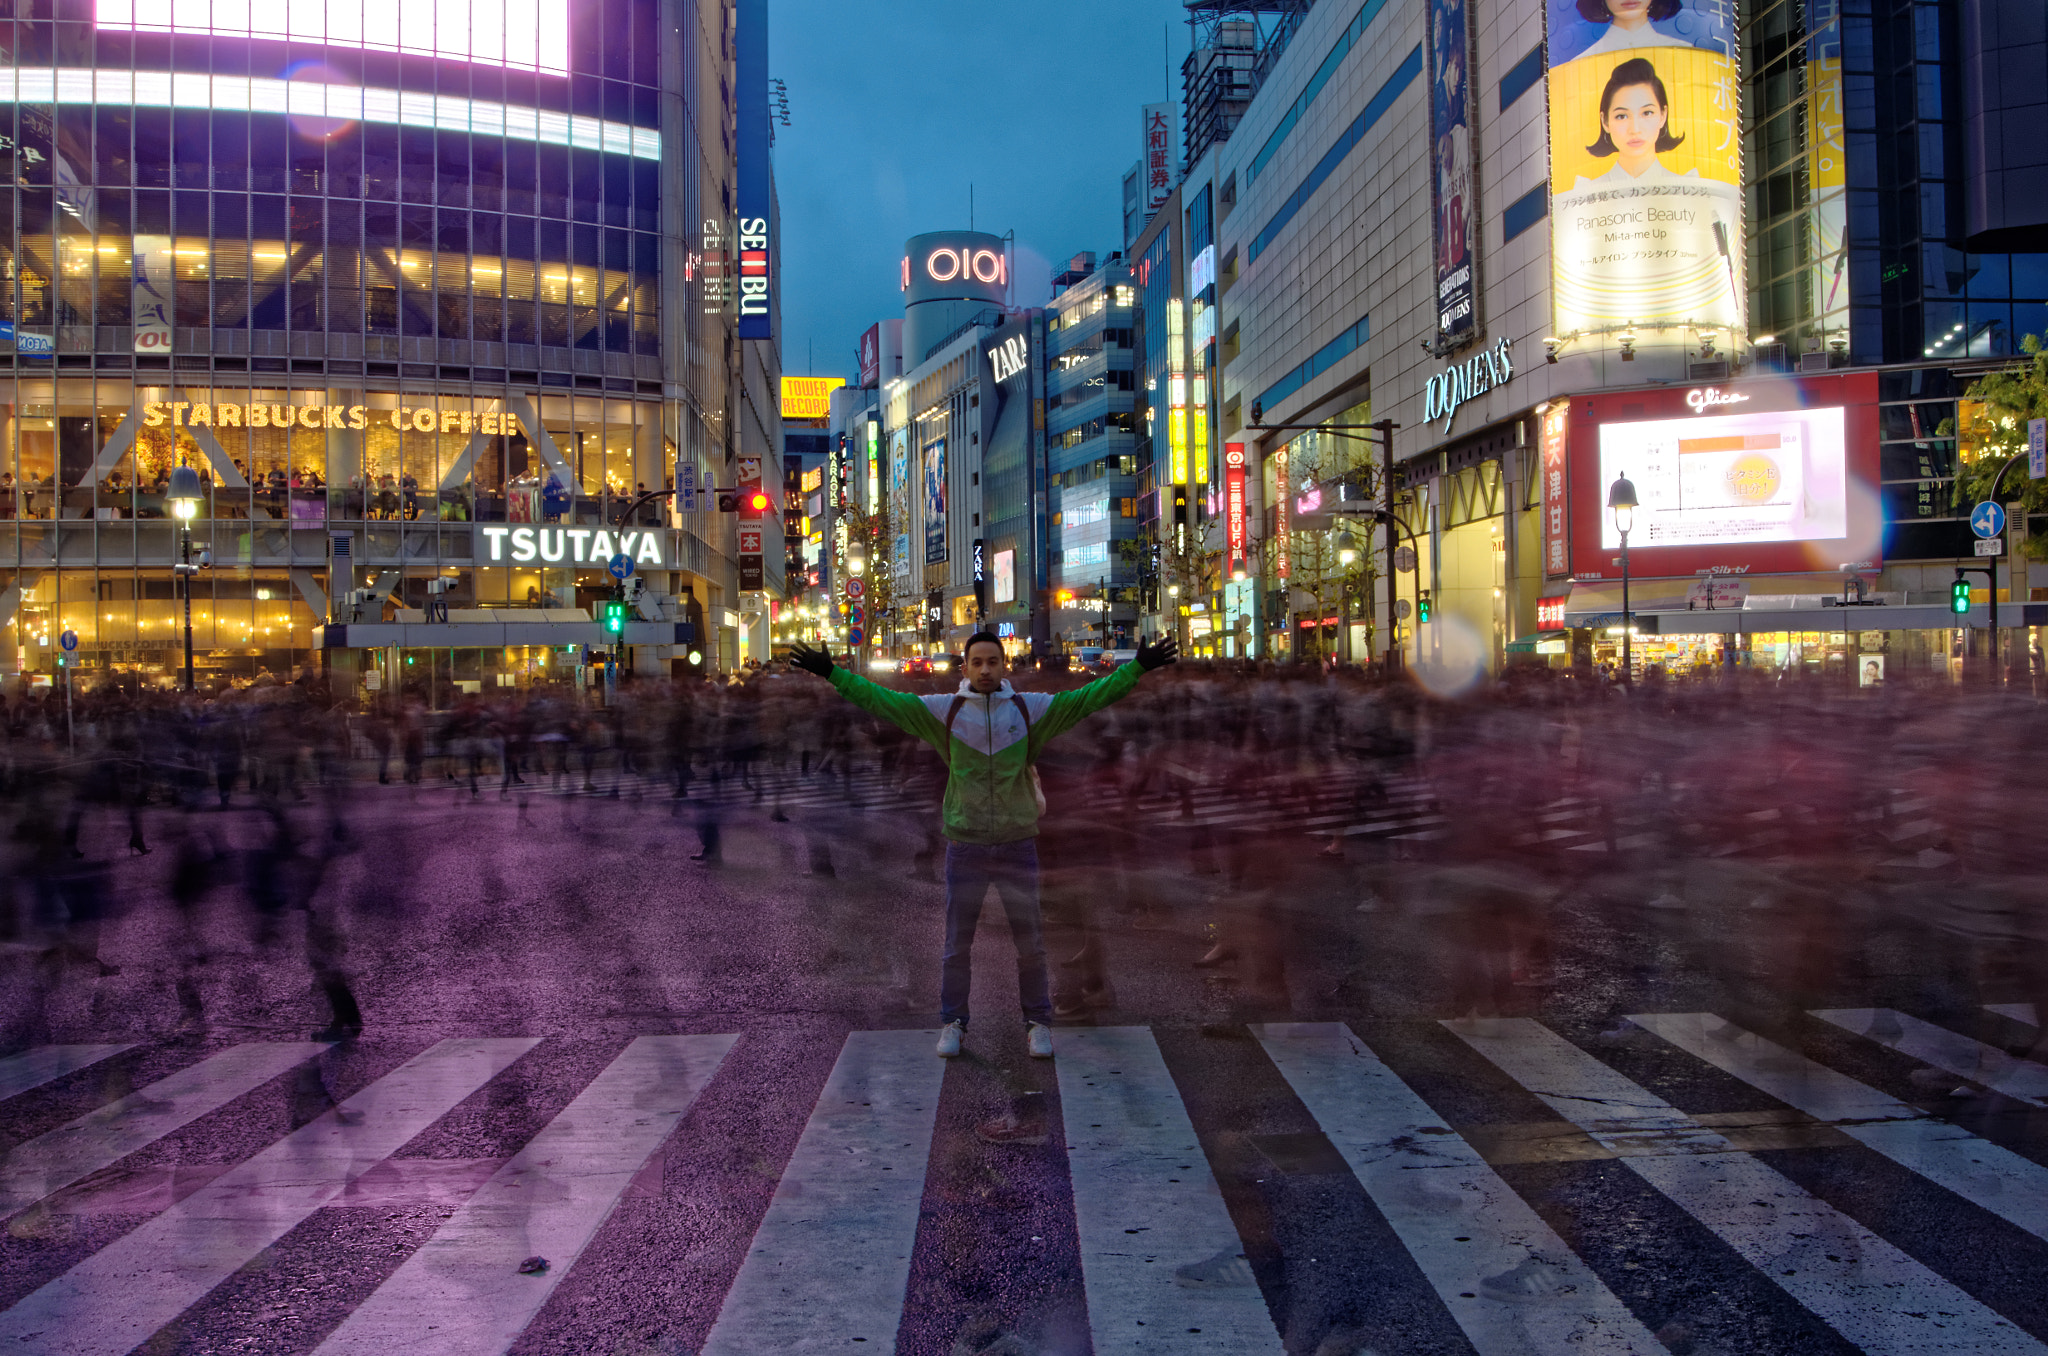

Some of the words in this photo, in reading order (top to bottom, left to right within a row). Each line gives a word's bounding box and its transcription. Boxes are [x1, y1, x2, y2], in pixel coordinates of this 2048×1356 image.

[1149, 111, 1169, 189] 大和証券
[1577, 209, 1643, 231] Panasonic
[1647, 207, 1696, 225] Beauty
[1604, 232, 1650, 243] Mi-ta-me
[1652, 229, 1667, 240] Up
[740, 218, 768, 316] SEIBU
[1632, 249, 1677, 260] ブラシタイプ
[988, 333, 1027, 384] ZARA
[787, 380, 828, 396] TOWER
[1423, 336, 1510, 435] 109MEN'S
[782, 397, 829, 414] RECORD
[1686, 388, 1749, 413] Glico
[143, 401, 368, 430] STARBUCKS
[391, 407, 517, 436] COFFEE
[829, 451, 839, 507] KARAOKE
[1725, 468, 1776, 481] ビタミンE
[684, 466, 694, 509] 渋谷駅前
[1548, 437, 1563, 569] 天津甘栗
[1230, 482, 1242, 559] 三菱東京UFJ銀
[483, 527, 662, 564] TSUTAYA
[743, 534, 758, 550] 本
[974, 546, 983, 581] ZARA
[1538, 604, 1564, 623] 天津甘栗
[998, 622, 1016, 638] ZARA
[1790, 632, 1819, 643] Free
[71, 641, 131, 651] TARBUCKS
[133, 639, 183, 650] COFFEE
